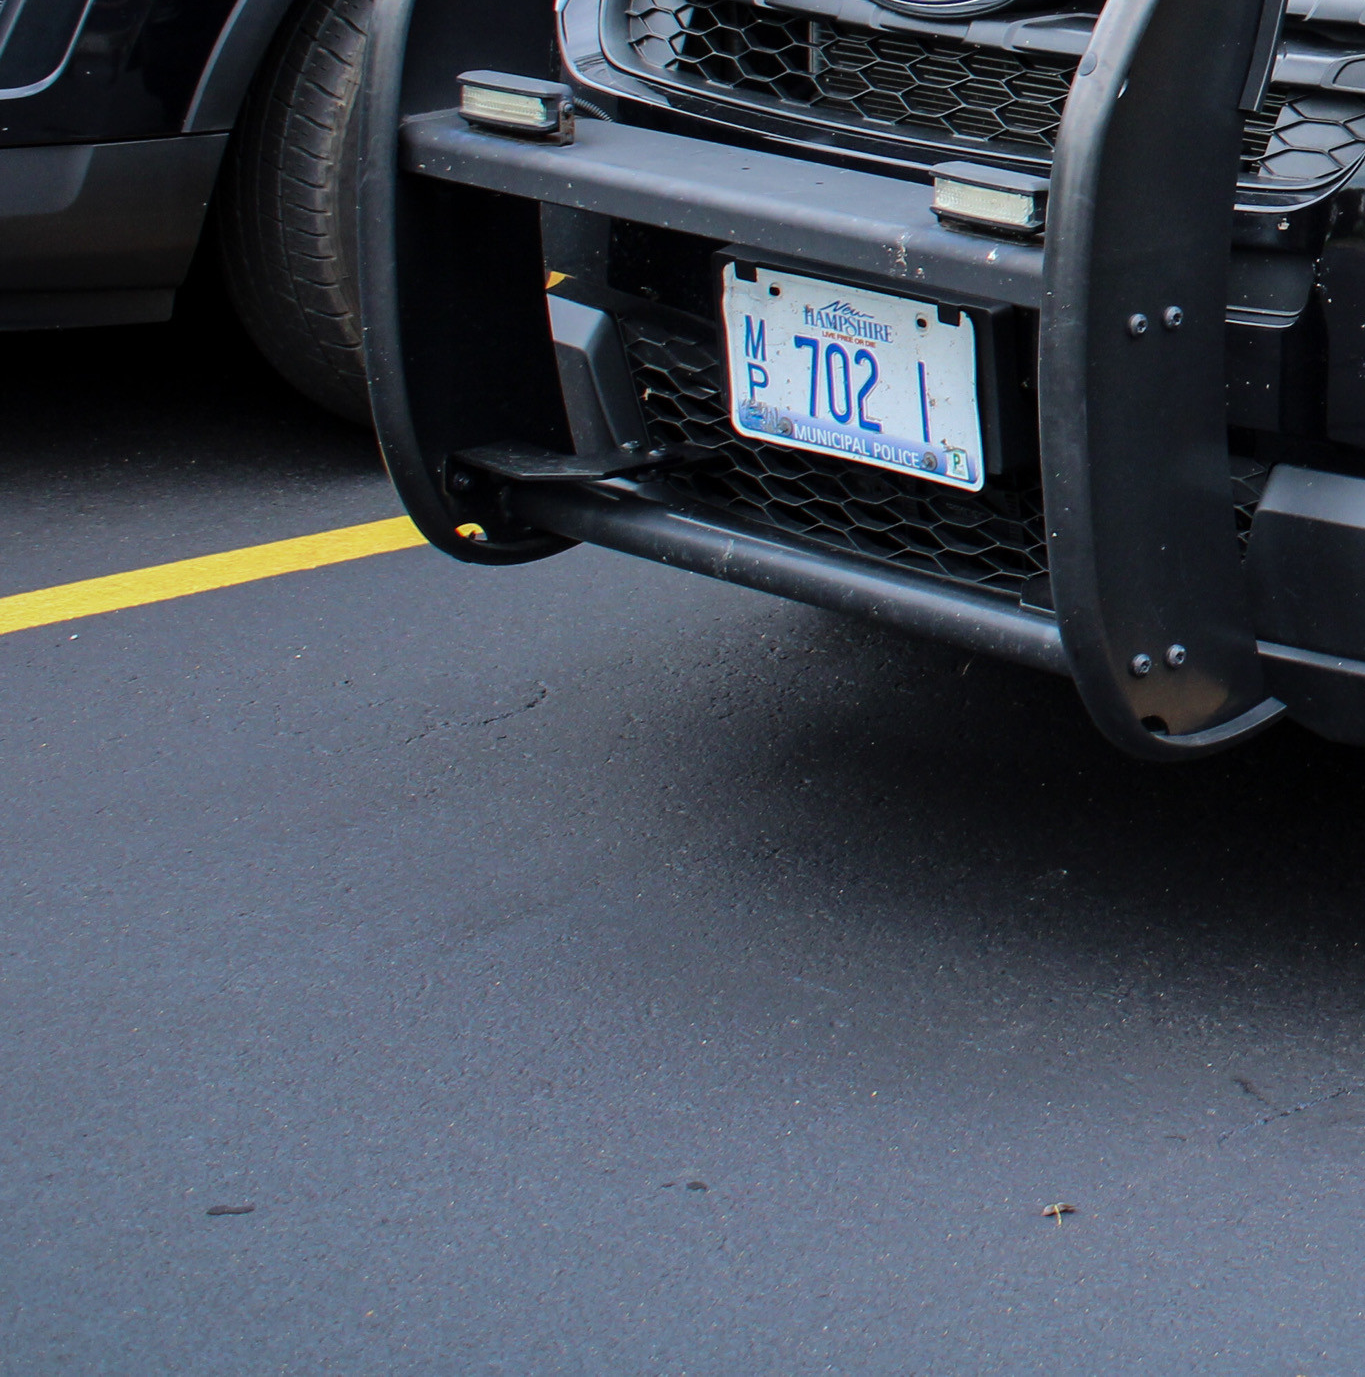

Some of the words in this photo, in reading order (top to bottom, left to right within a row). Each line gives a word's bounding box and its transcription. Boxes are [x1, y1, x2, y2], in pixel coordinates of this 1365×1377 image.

[804, 305, 894, 344] HAMPSHIRE
[820, 300, 875, 319] New
[822, 331, 835, 340] LIVE
[794, 334, 883, 433] 702
[794, 423, 870, 457] MUNICIPAL
[873, 441, 920, 469] POLICE
